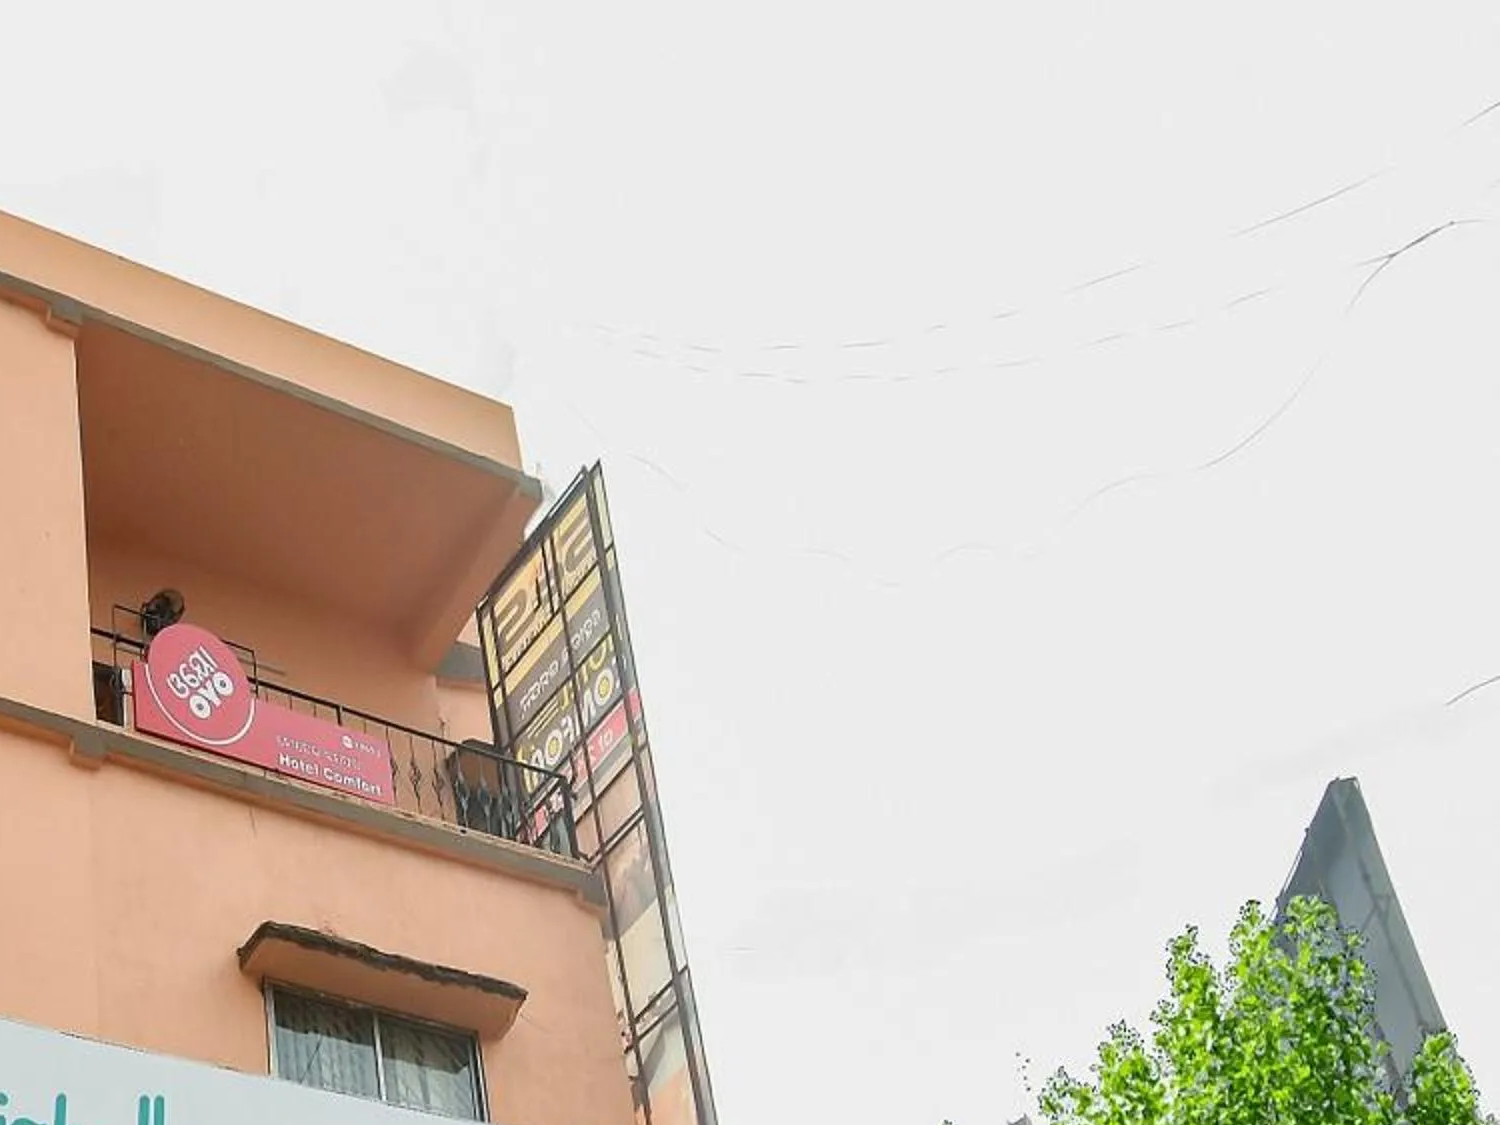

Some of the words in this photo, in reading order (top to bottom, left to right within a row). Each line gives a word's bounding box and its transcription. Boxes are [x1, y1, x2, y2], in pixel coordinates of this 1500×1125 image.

[190, 671, 234, 719] OYO
[278, 753, 319, 778] Hotel
[323, 767, 381, 796] Comfort
